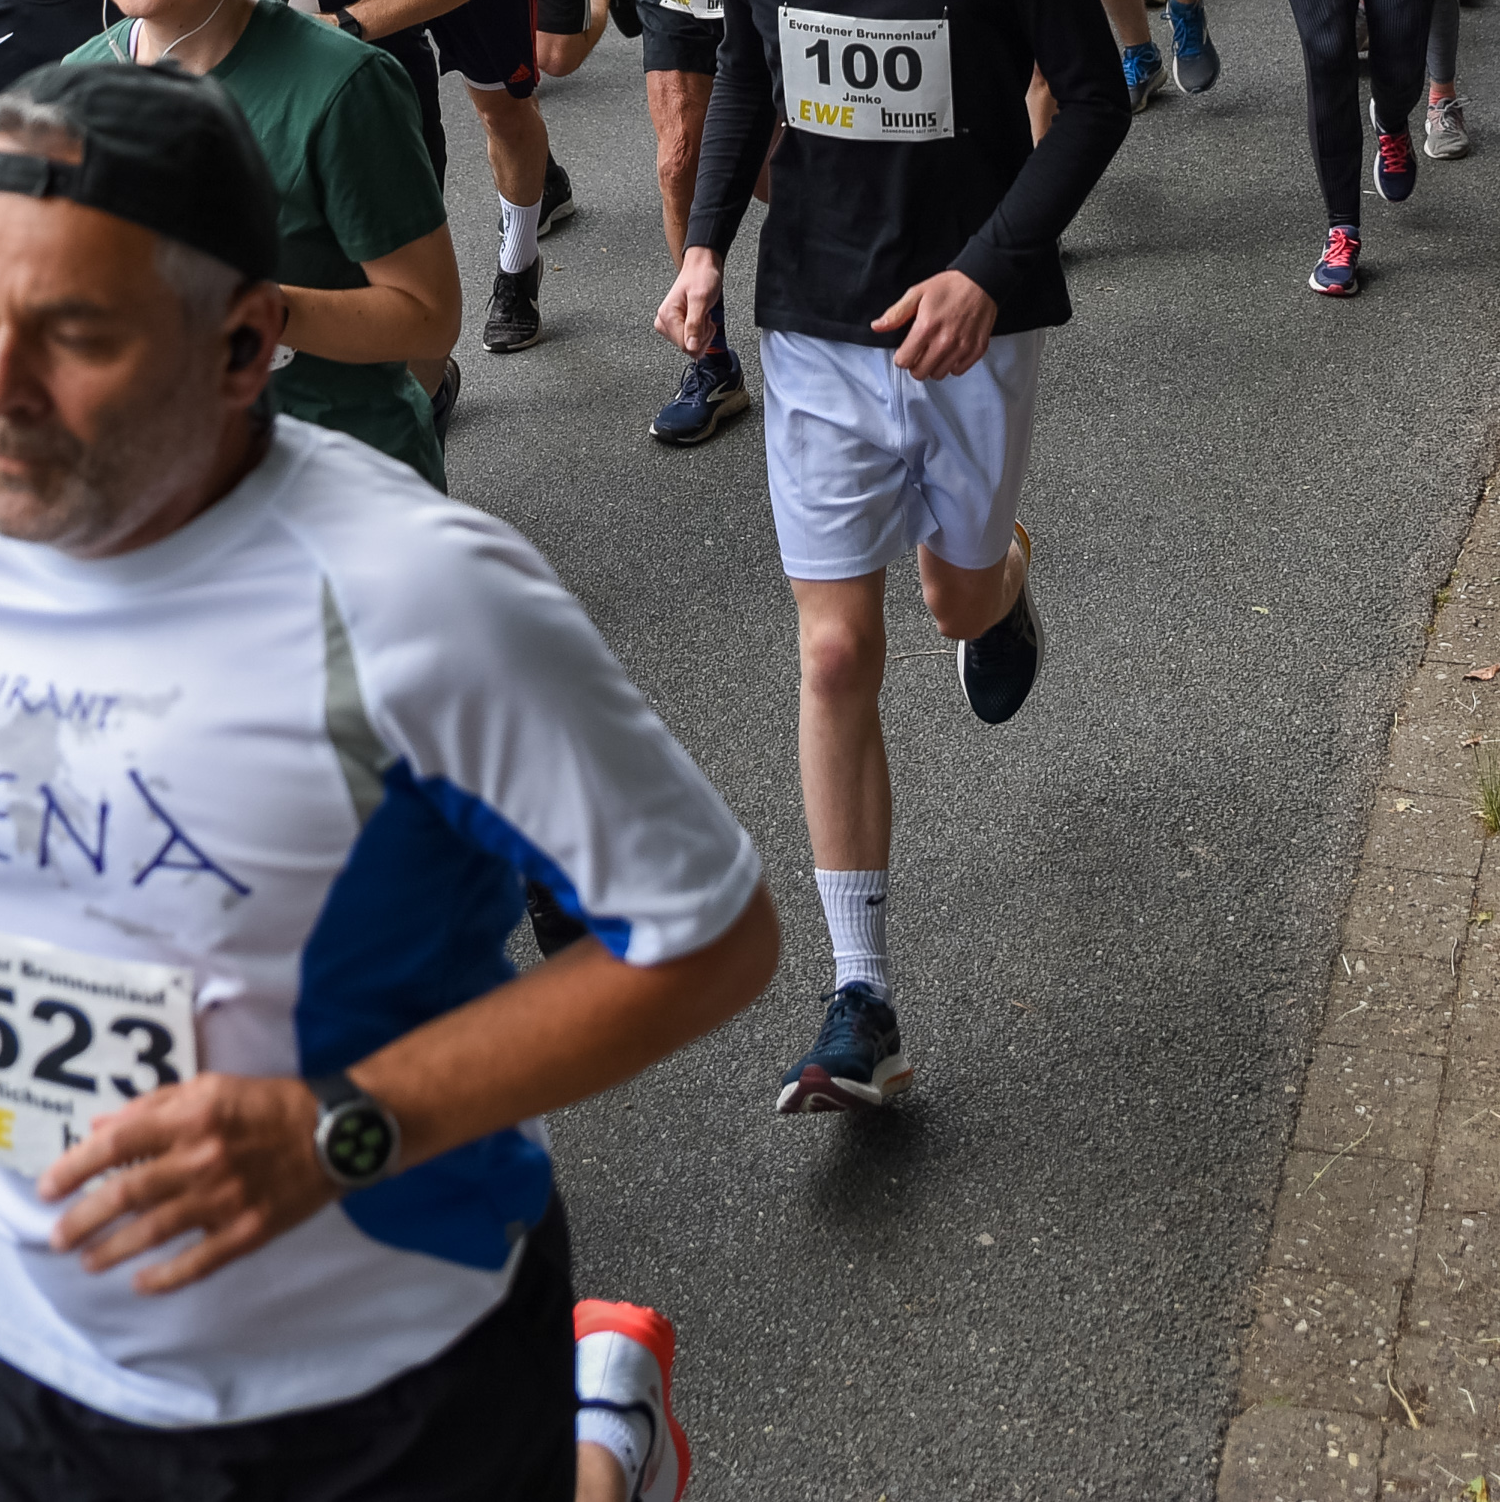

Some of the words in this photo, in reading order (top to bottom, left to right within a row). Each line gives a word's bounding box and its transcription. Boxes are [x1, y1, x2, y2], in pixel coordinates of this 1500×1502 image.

[789, 19, 853, 38] Everstener
[856, 29, 938, 41] Brunnenlauf
[805, 39, 923, 92] 100
[842, 92, 882, 105] Janko
[800, 99, 855, 129] EWE
[881, 107, 937, 128] bruns
